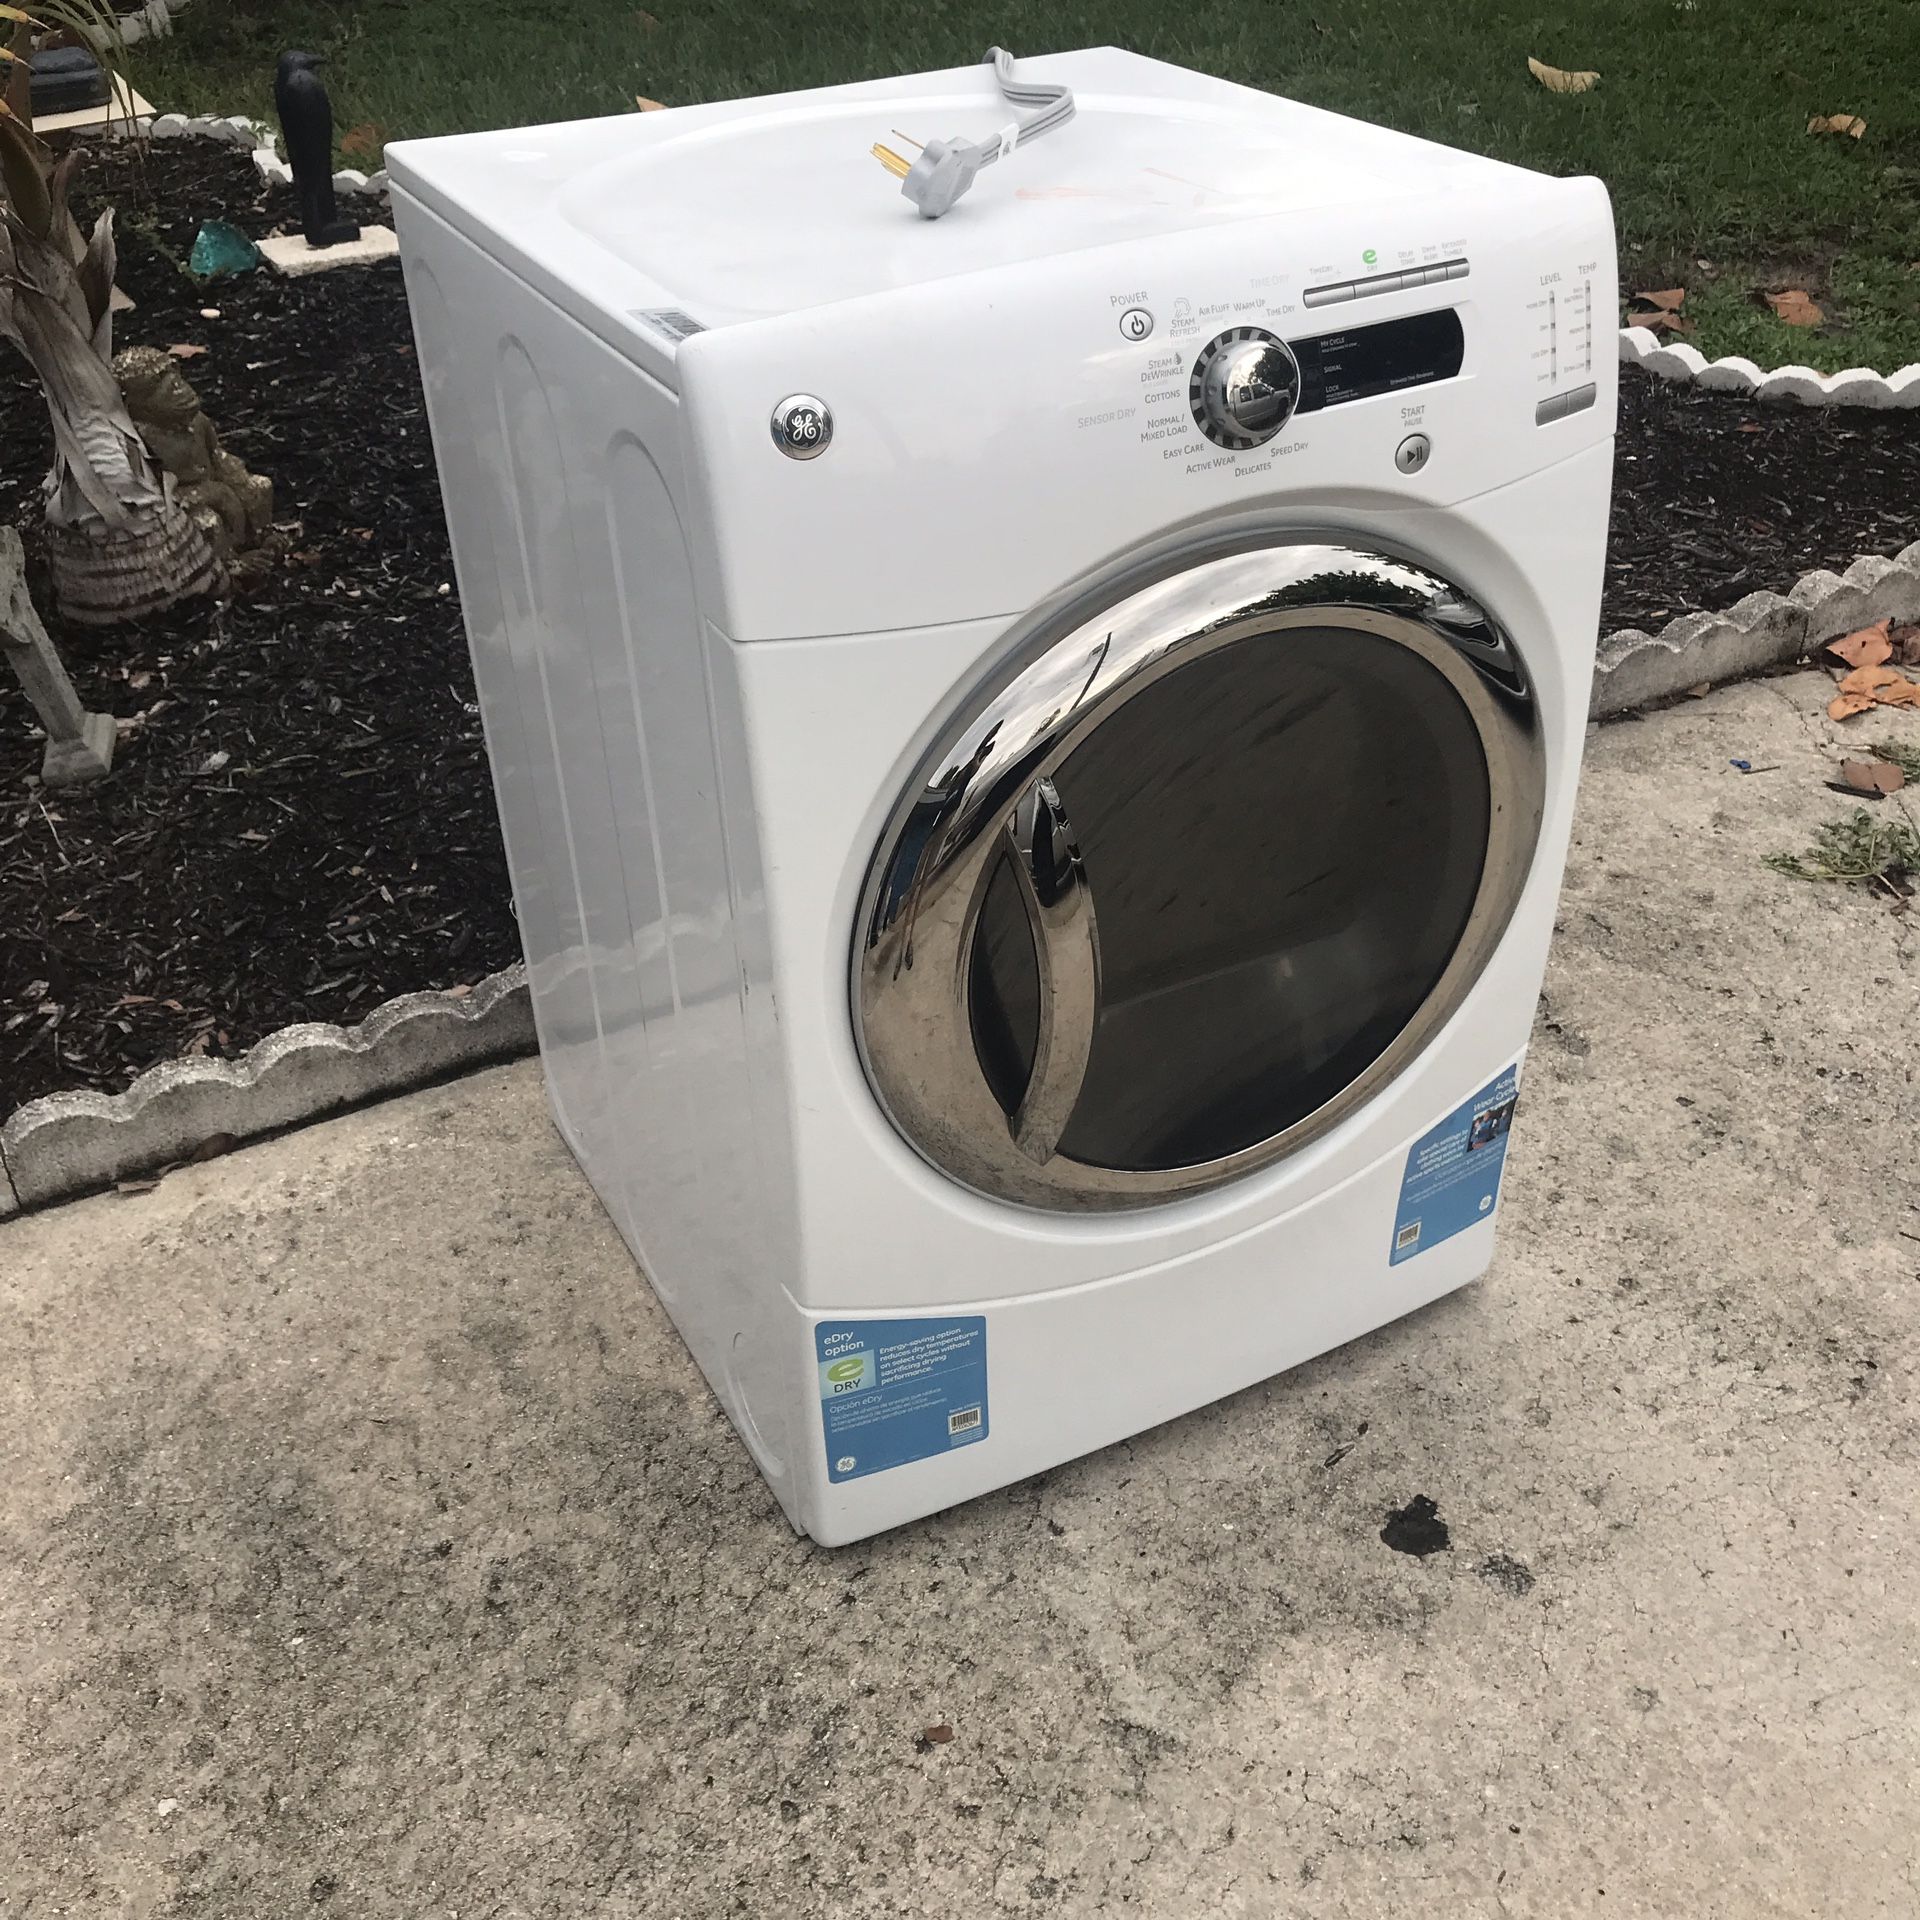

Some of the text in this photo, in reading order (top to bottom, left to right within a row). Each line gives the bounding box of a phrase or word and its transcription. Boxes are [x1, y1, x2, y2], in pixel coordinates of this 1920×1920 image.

[1578, 261, 1597, 275] TEMP
[1540, 272, 1562, 286] LEVEL
[1110, 291, 1149, 307] POWER
[1233, 298, 1266, 312] WARM UP
[1199, 303, 1230, 317] AIR FLUFF
[1266, 304, 1295, 317] TIME DRY
[1171, 317, 1195, 329] STEAM
[1170, 326, 1200, 338] REFRESH
[1148, 358, 1172, 370] STEAM
[1144, 389, 1181, 404] COTTONS
[1078, 407, 1136, 429] SENSOR DRY
[1400, 404, 1425, 419] START
[1147, 415, 1180, 429] NORMAL
[1140, 425, 1188, 443] MIXED LOAD
[1163, 443, 1205, 460] EASY CARE
[1270, 442, 1309, 458] SPEED DRY
[1186, 455, 1236, 475] ACTIVE WEAR
[1234, 462, 1272, 477] DELICATES
[824, 1331, 854, 1345] eDry
[879, 1328, 961, 1354] Energy-saving option
[824, 1341, 864, 1356] option
[880, 1330, 979, 1362] reduces dry temperatures
[891, 1355, 915, 1367] select
[915, 1348, 940, 1360] cycles
[940, 1340, 970, 1353] without
[881, 1354, 947, 1377] sacrificing drying
[834, 1378, 861, 1393] DRY
[862, 1394, 883, 1405] eDry
